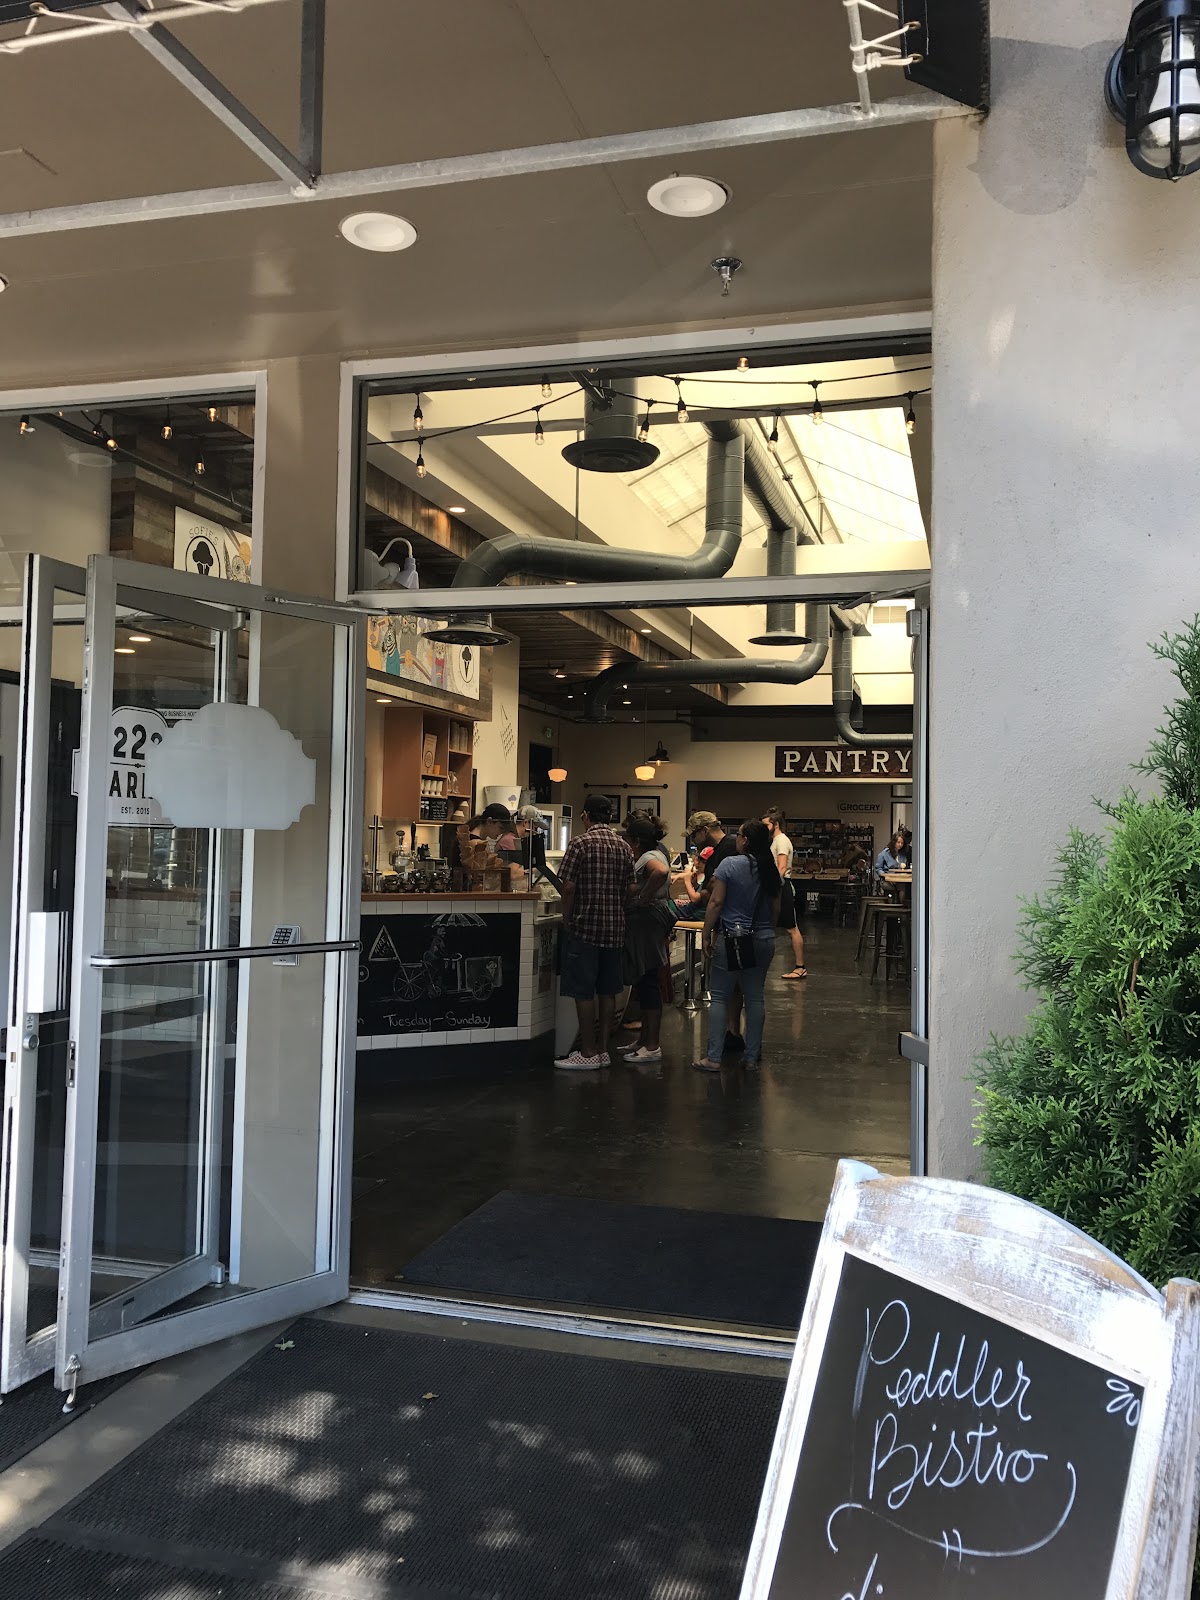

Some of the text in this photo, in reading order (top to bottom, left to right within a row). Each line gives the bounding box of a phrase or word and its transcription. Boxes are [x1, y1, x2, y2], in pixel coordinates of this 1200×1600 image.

[783, 750, 911, 773] PANTRY
[121, 807, 134, 815] EST.
[840, 803, 880, 811] GROCERY
[853, 1300, 1032, 1421] Peddler
[868, 1413, 1048, 1509] Bistro
